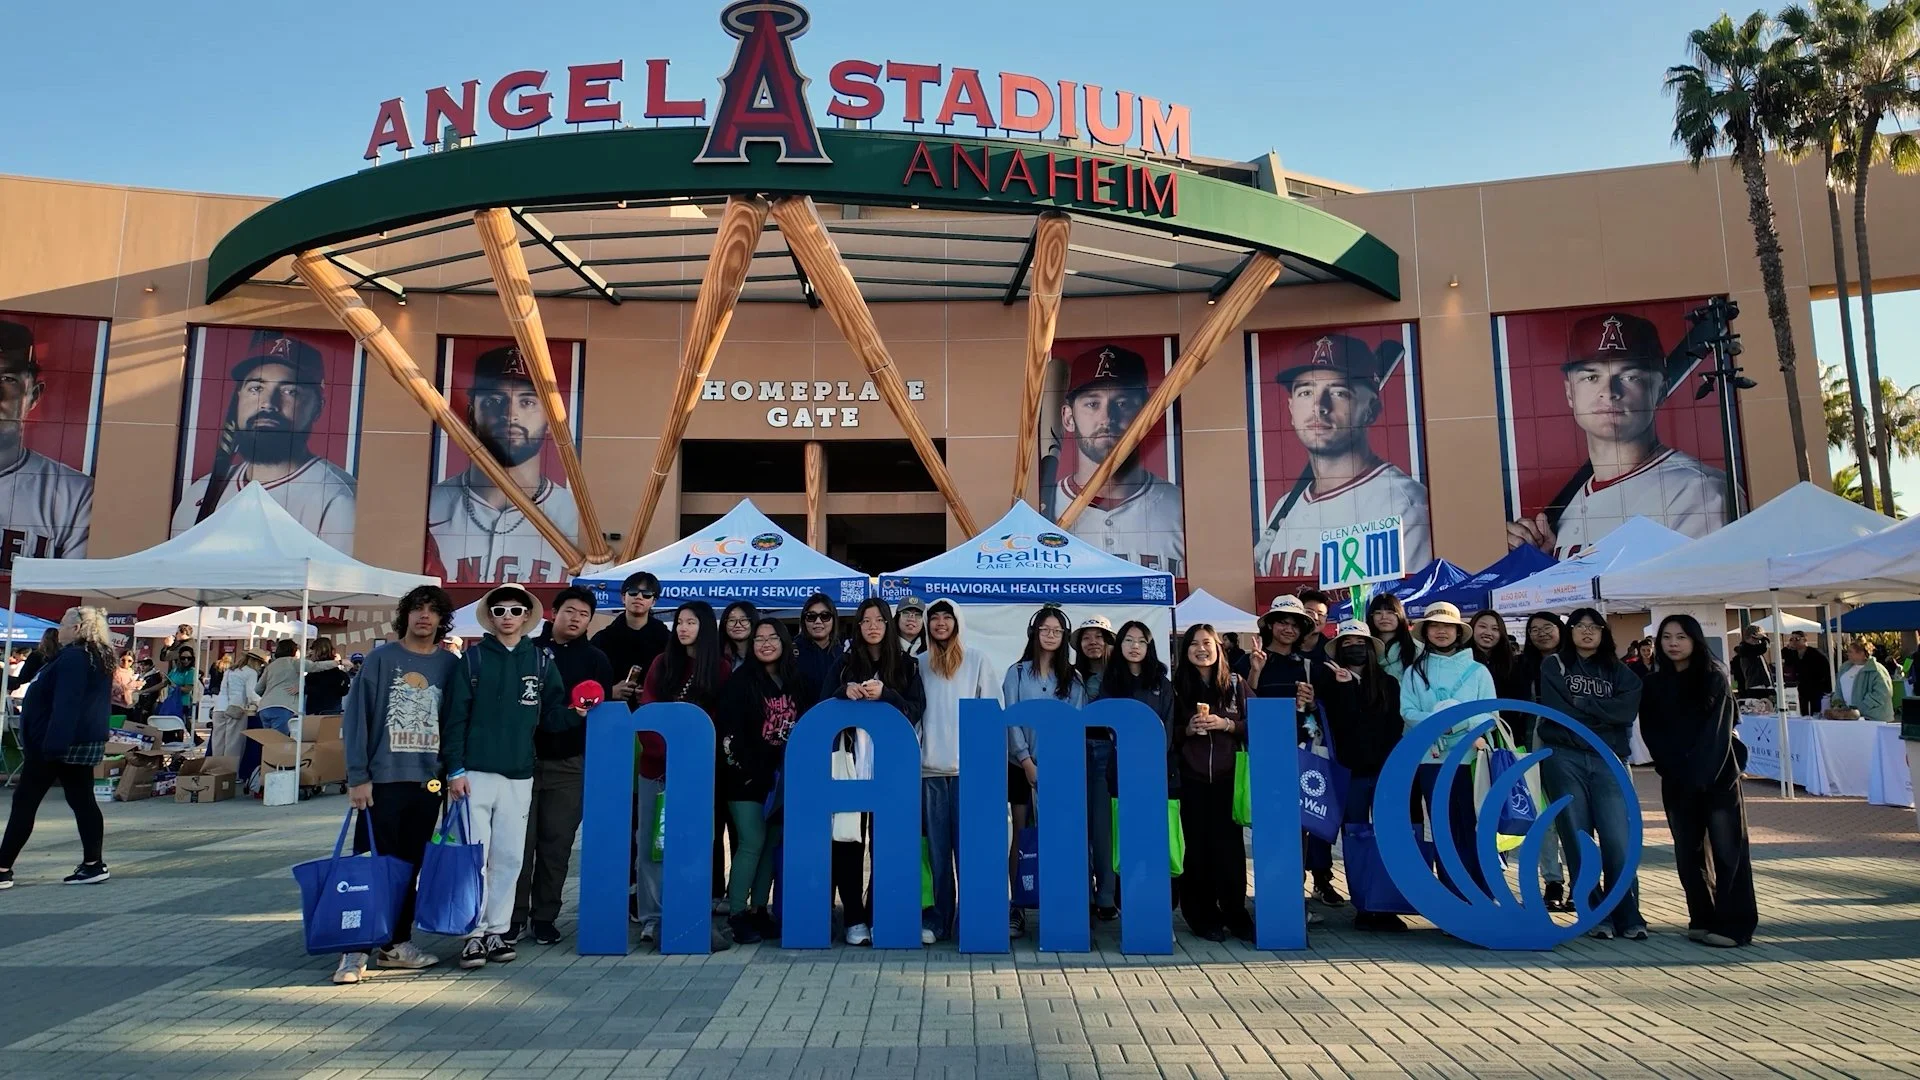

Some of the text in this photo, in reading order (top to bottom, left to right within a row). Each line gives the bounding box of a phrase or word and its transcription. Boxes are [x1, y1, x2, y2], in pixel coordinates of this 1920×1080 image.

[364, 59, 706, 160] ANGEL
[827, 60, 1192, 161] STADIUM
[903, 140, 1179, 216] ANAHEIM
[701, 380, 925, 401] HOMEPLAE
[766, 406, 860, 428] GATE
[1321, 527, 1349, 542] GLEN
[1360, 516, 1400, 533] WILSON
[682, 553, 780, 567] health
[976, 547, 1072, 564] health
[976, 561, 1072, 570] CARE AGENCY
[708, 586, 759, 597] HEALTH
[761, 586, 821, 598] SERVICES
[882, 587, 913, 596] health
[925, 582, 1123, 595] BEHAVIORAL HEALTH SERVICES
[1304, 797, 1327, 817] Well
